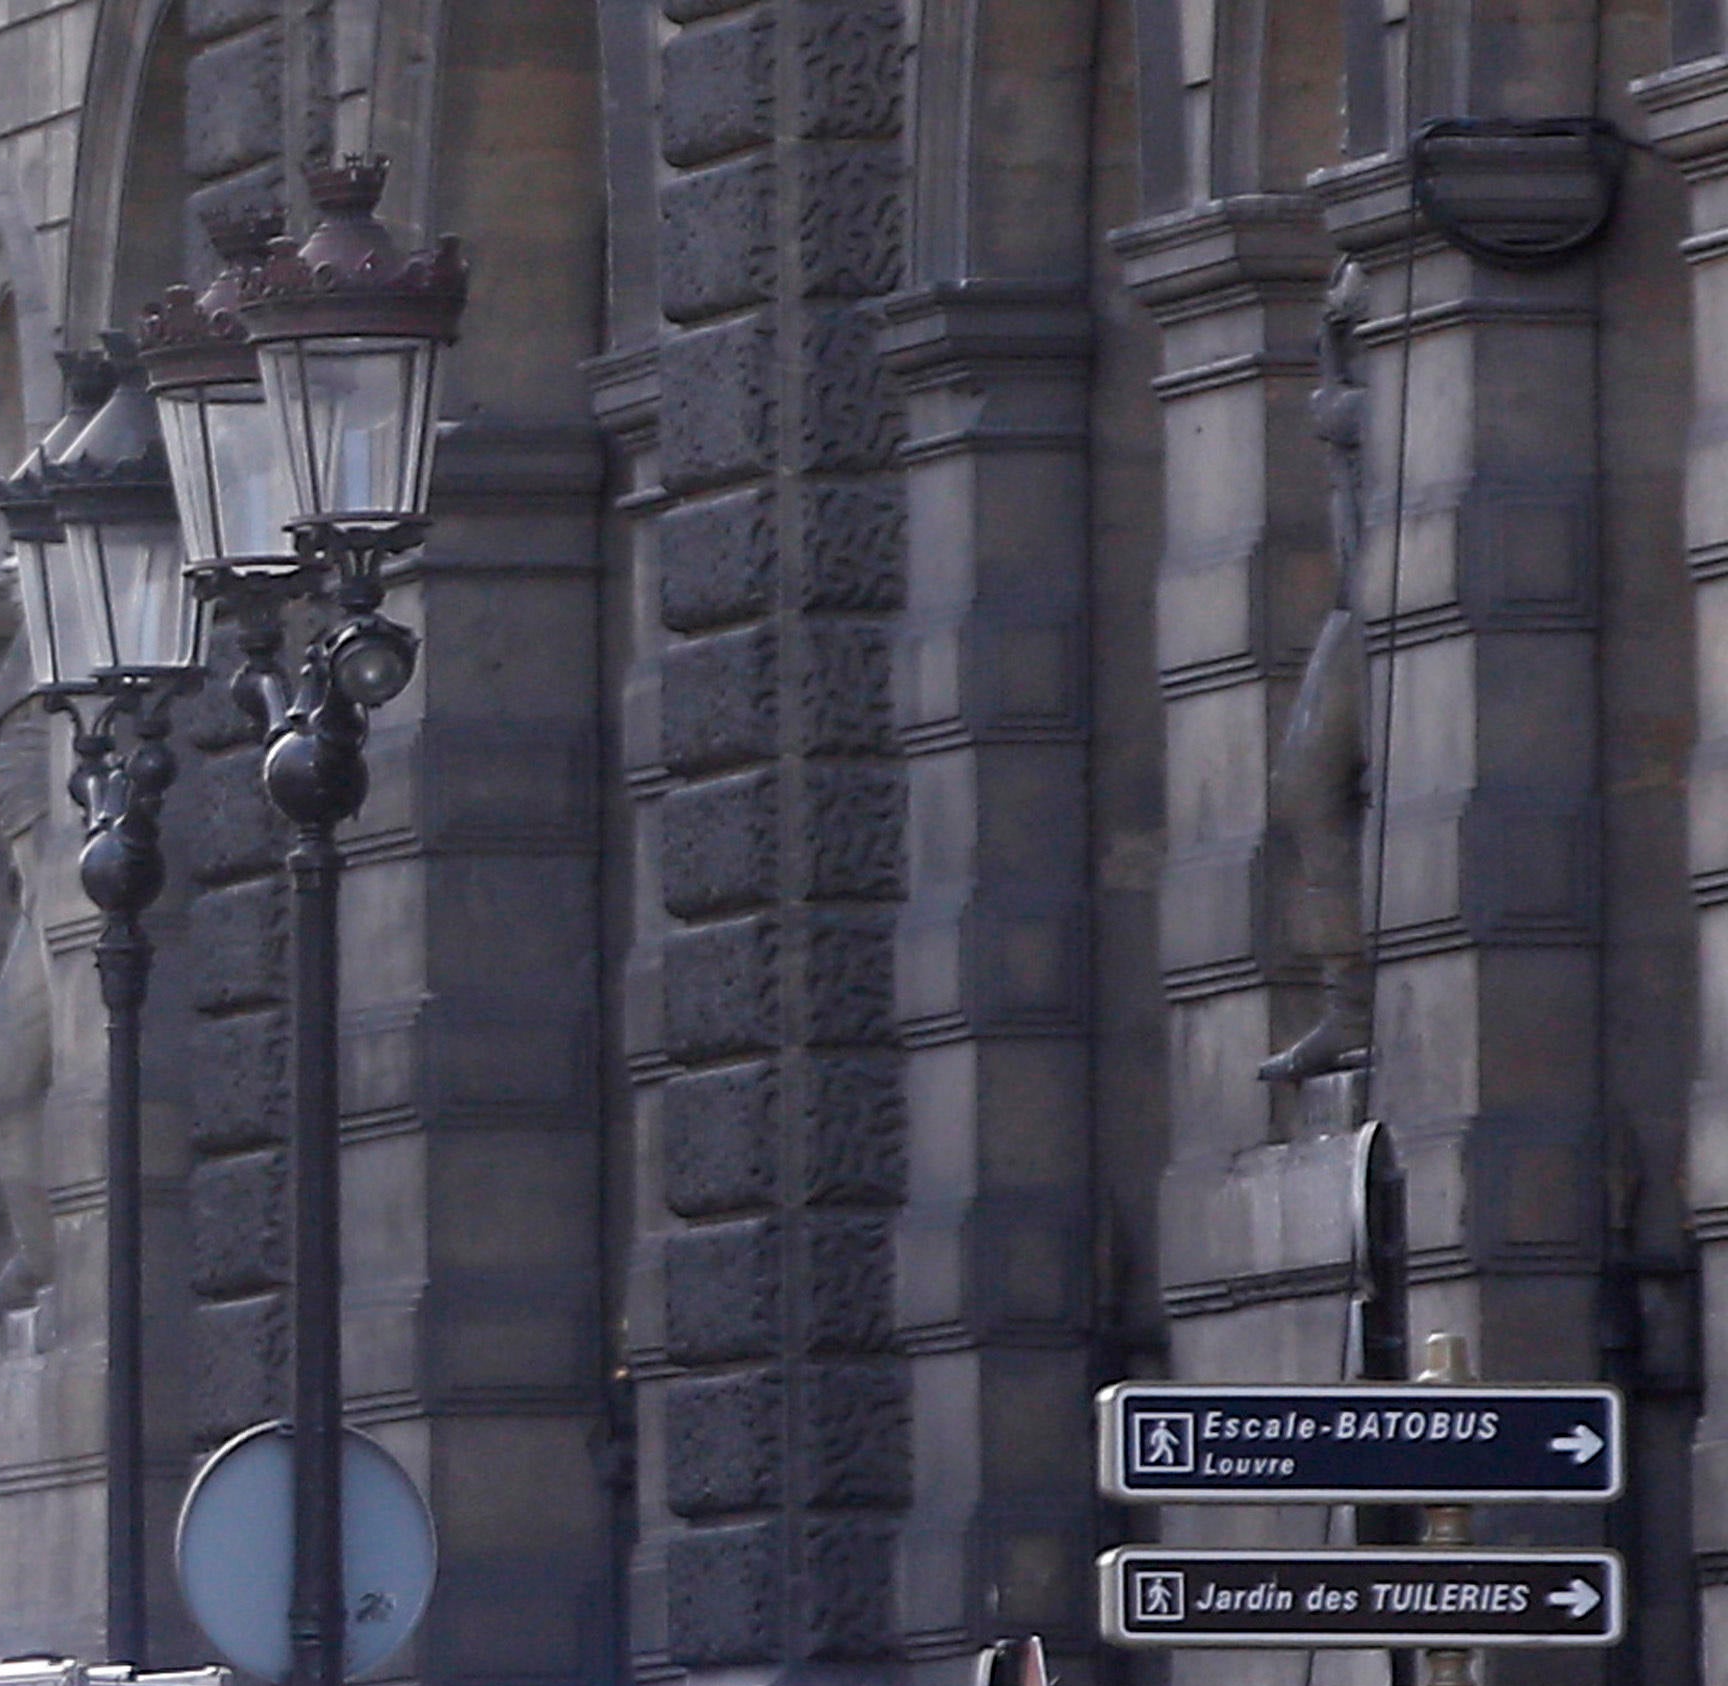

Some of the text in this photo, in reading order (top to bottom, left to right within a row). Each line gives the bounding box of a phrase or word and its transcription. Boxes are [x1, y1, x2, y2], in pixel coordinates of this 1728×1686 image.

[1203, 1410, 1499, 1440] Escale-BATOBUS
[1204, 1452, 1295, 1475] Louvre
[1196, 1582, 1531, 1612] Jardin des TUILERIES
